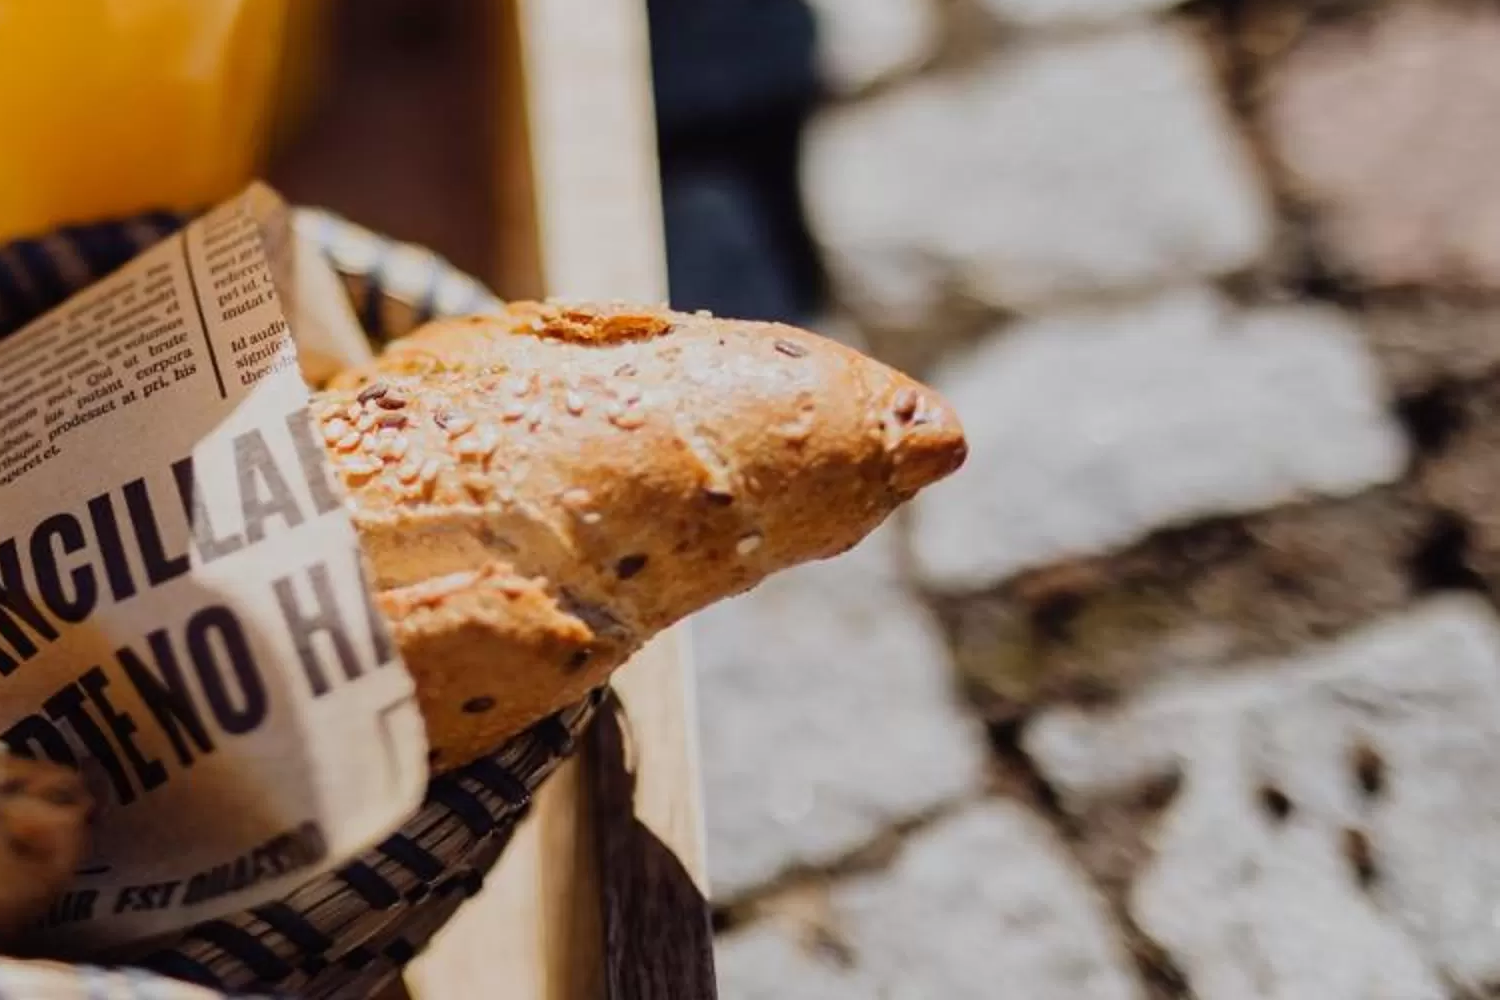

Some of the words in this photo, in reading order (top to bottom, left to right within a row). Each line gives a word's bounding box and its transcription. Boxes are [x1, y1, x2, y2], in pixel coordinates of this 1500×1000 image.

[86, 365, 113, 387] Qui
[148, 332, 187, 356] brute
[135, 348, 193, 380] corpora
[121, 389, 137, 405] at
[173, 363, 196, 381] his
